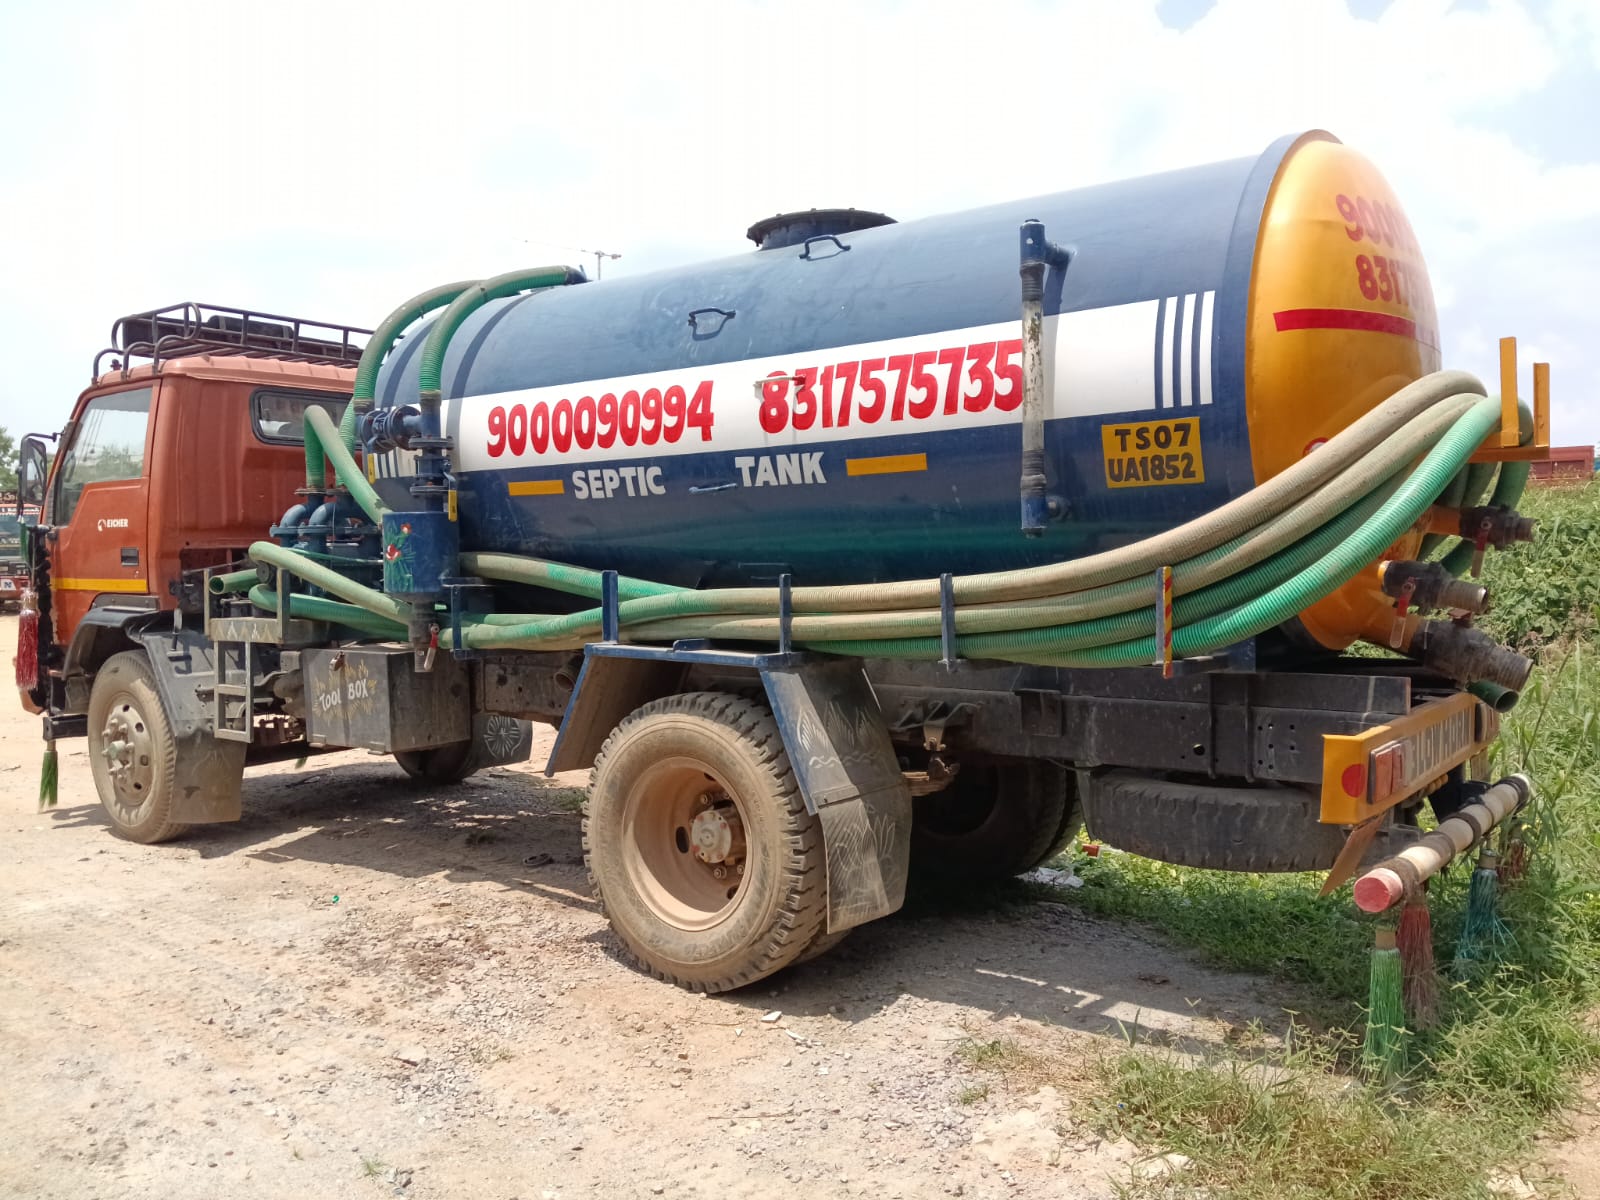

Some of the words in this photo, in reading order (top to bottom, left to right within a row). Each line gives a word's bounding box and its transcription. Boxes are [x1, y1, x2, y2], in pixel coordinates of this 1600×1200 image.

[487, 380, 714, 458] 9000090994
[758, 338, 1023, 434] 8317575735
[1115, 423, 1191, 452] TS07
[572, 466, 666, 500] SEPTIC
[734, 451, 827, 488] TANK
[1108, 452, 1196, 482] UA1852
[348, 678, 368, 700] BOX
